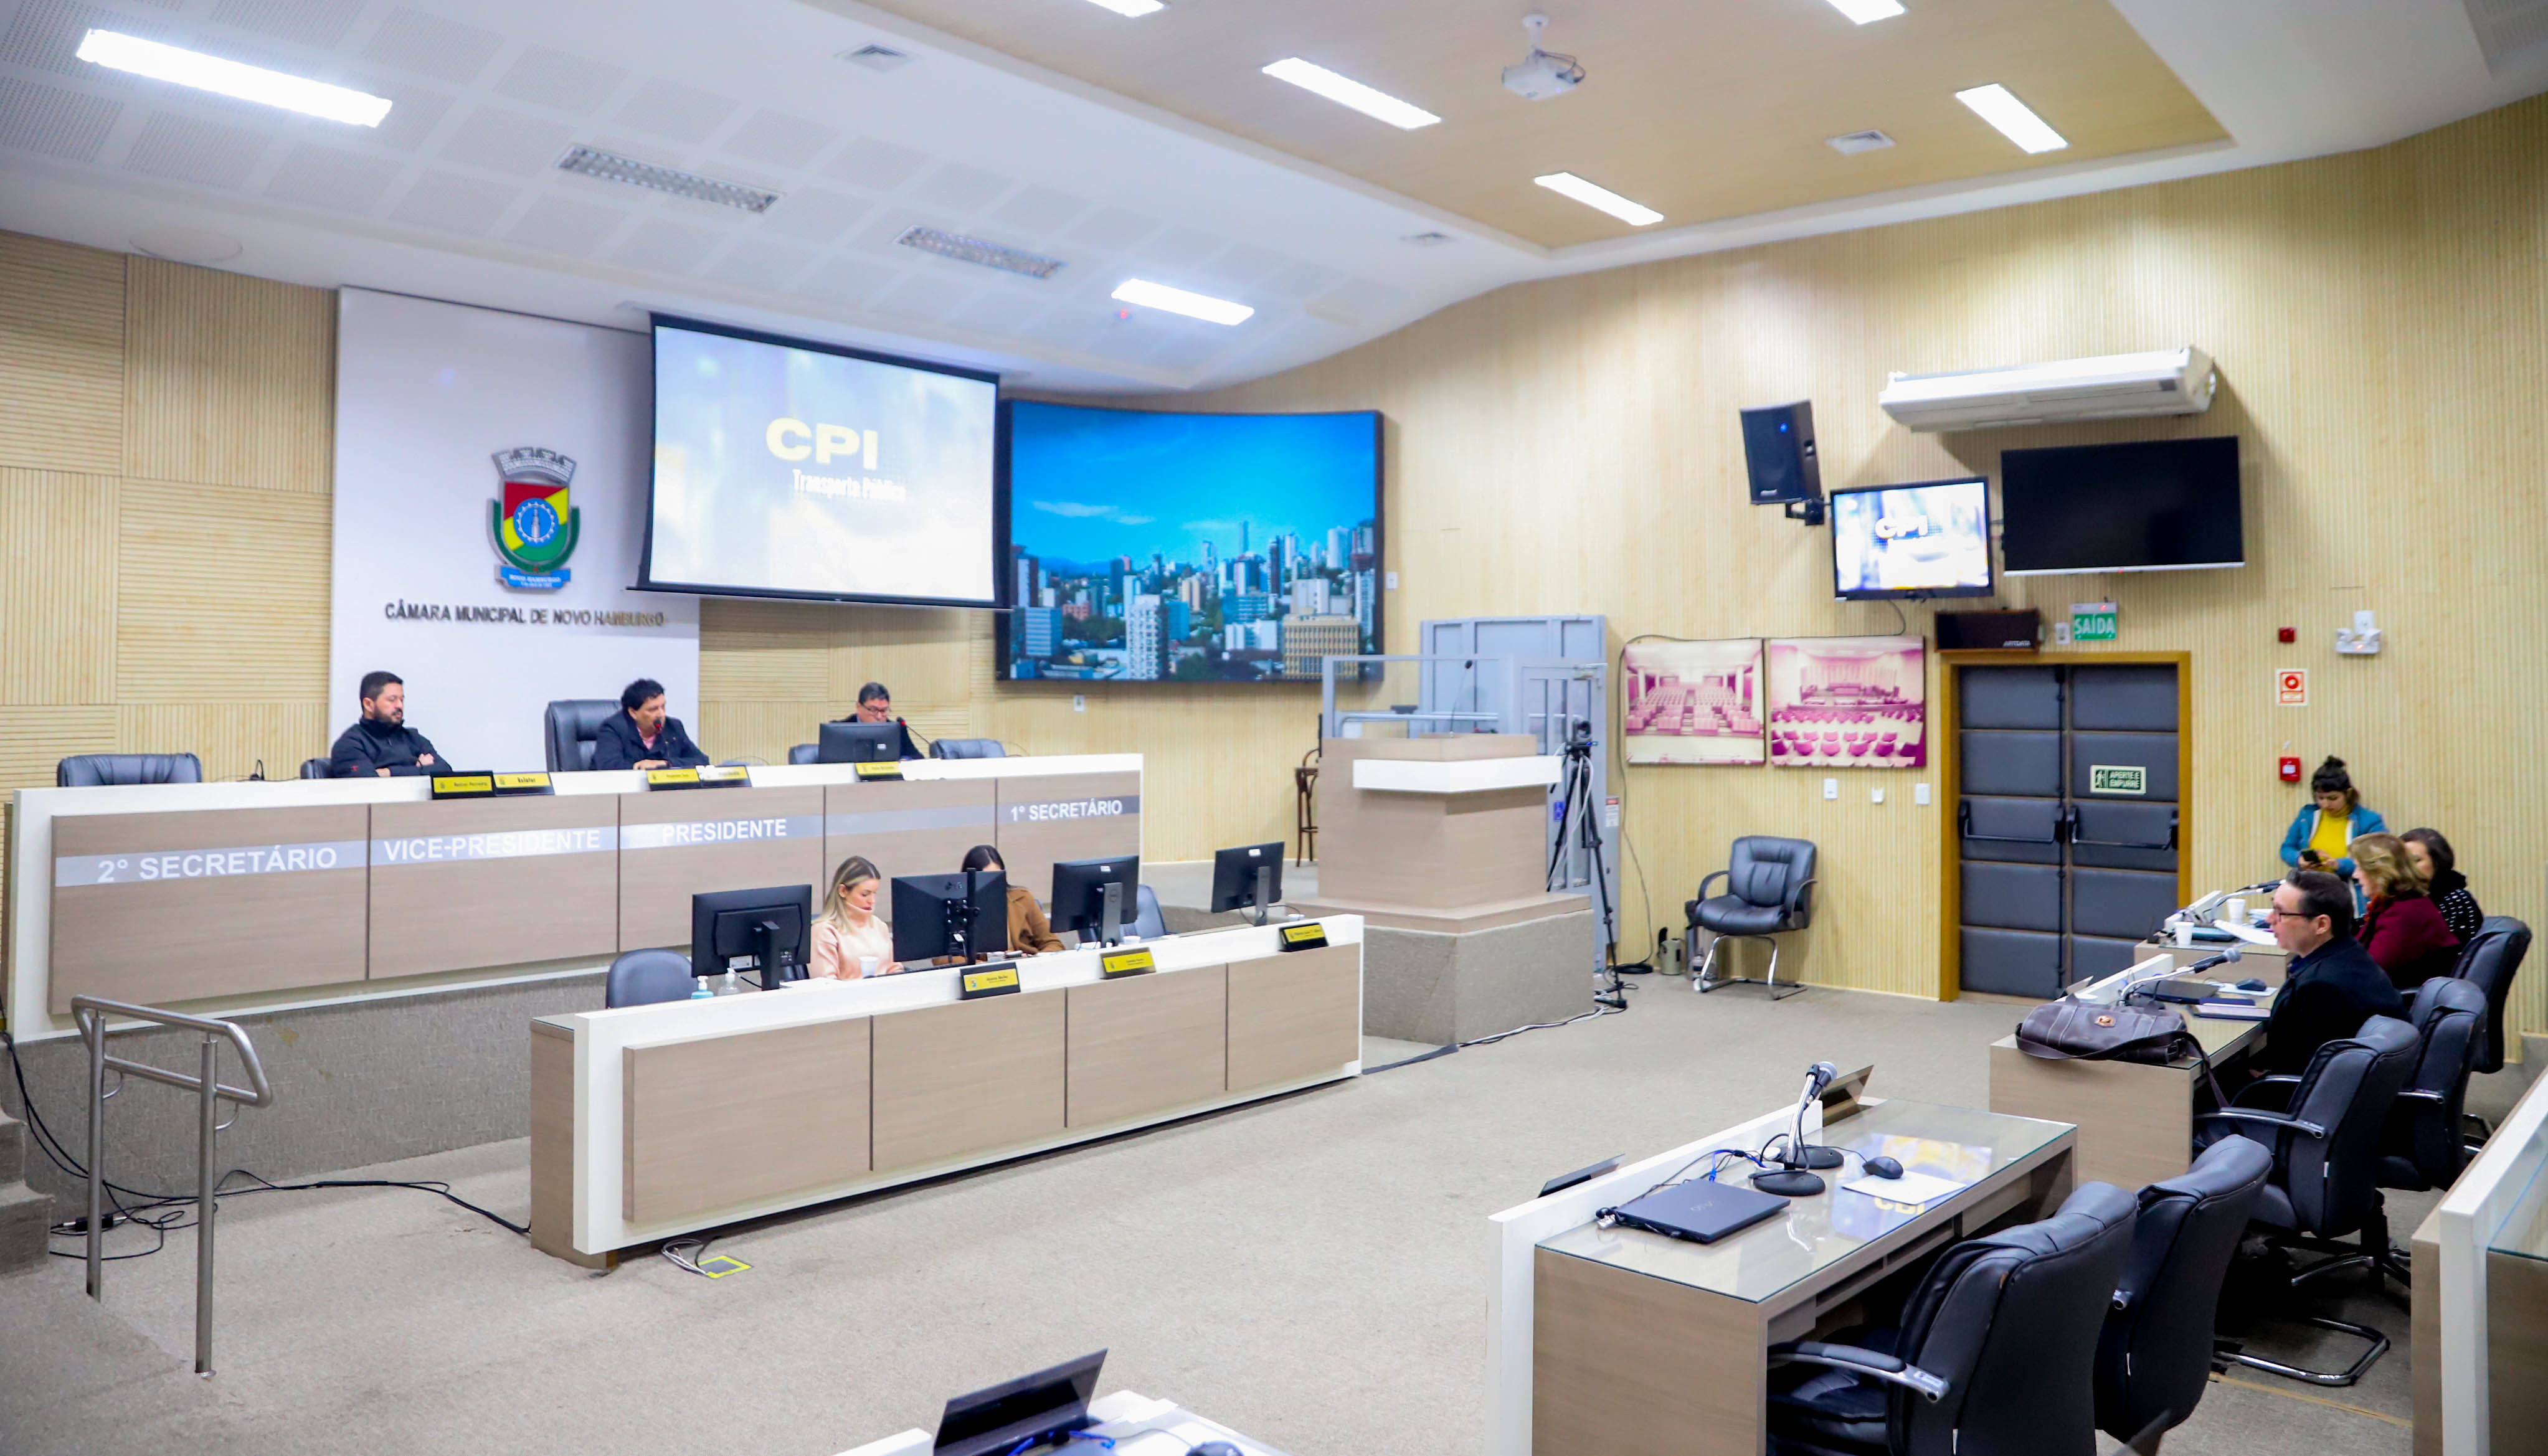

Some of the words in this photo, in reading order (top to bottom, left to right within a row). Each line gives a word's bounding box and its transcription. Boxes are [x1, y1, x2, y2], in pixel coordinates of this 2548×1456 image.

[765, 417, 878, 471] CPI
[1875, 514, 1928, 539] CPI
[385, 598, 452, 619] CÂMARA
[455, 605, 527, 623] MUNICIPAL
[530, 608, 548, 624] DE
[552, 609, 591, 625] NOVO
[594, 610, 665, 626] HAMBURGO
[2075, 613, 2115, 635] SAÍDA
[1029, 798, 1123, 821] SECRETÁRIO
[662, 818, 787, 844] PRESIDENTE
[384, 830, 601, 861] VICE-PRESIDENTE
[138, 844, 337, 880] SECRETÁRIO
